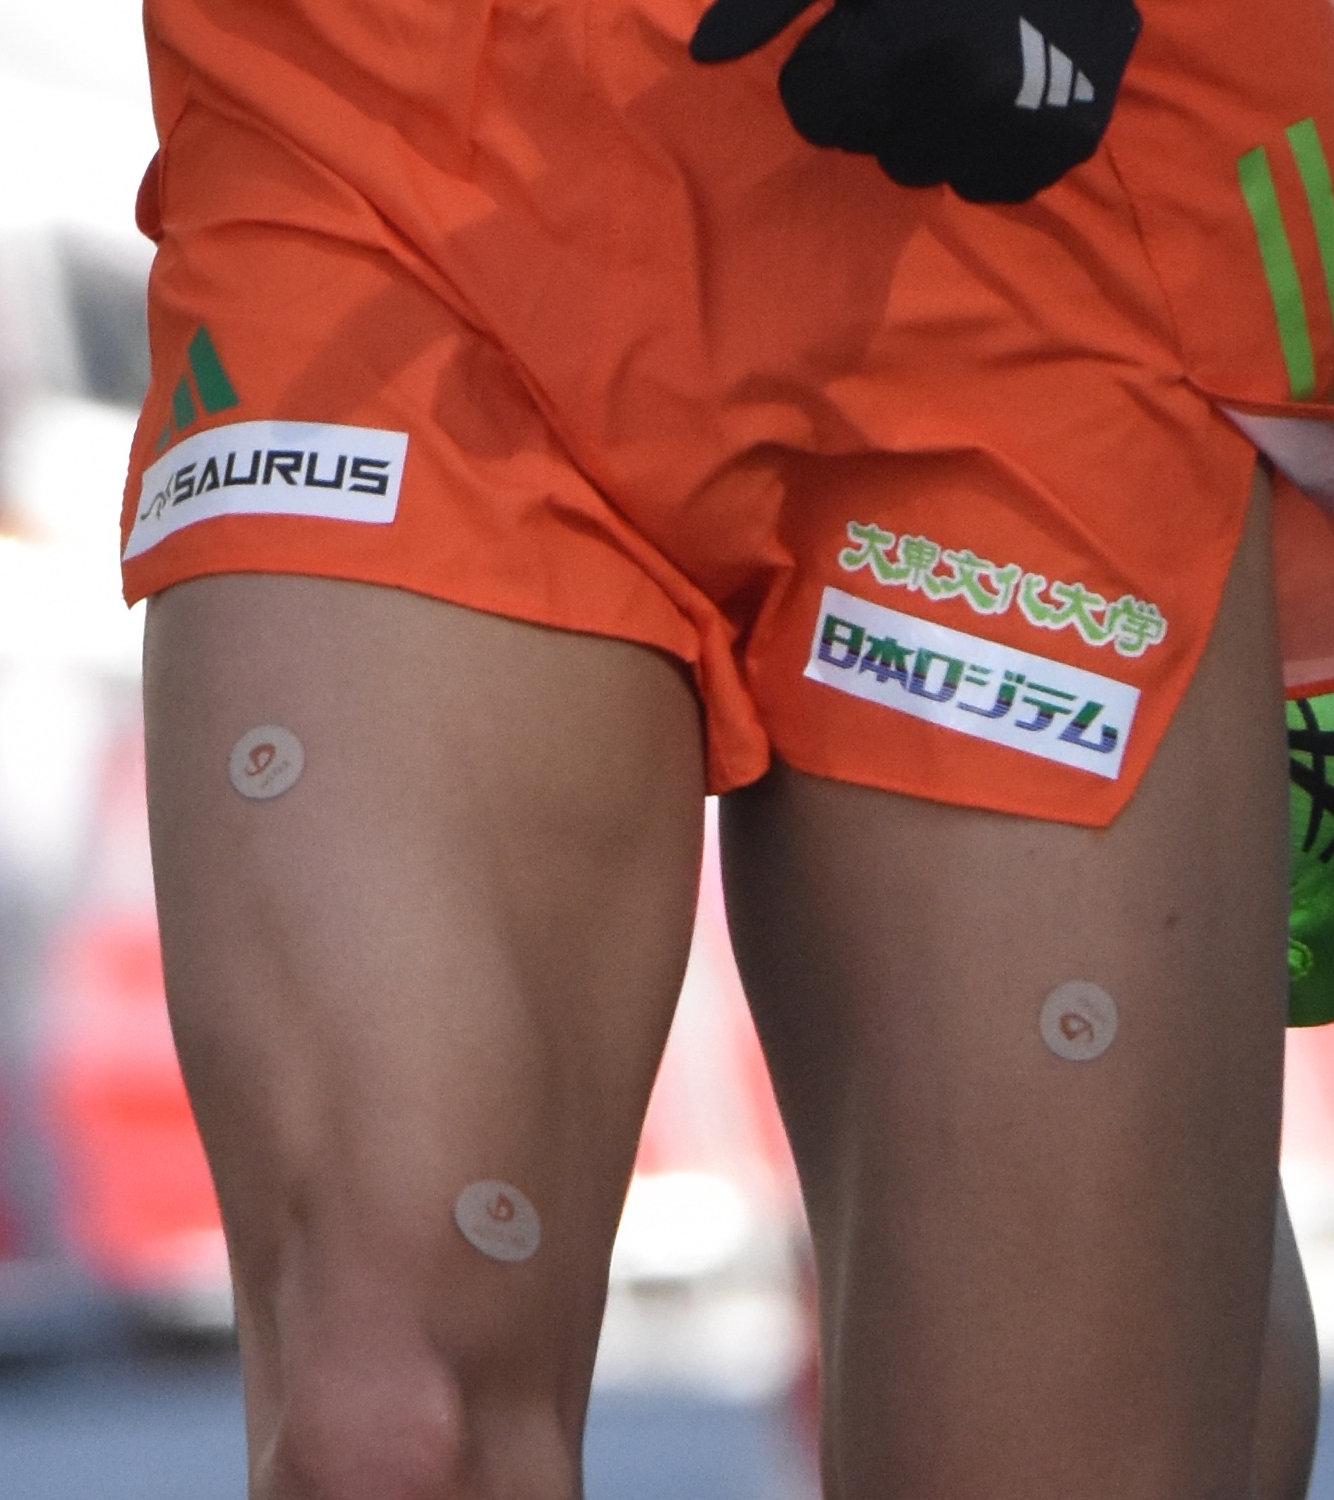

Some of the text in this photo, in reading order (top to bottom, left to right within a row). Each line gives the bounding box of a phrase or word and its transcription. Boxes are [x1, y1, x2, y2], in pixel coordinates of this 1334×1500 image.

[838, 521, 1167, 658] 大東文化大学
[816, 612, 1120, 755] 日本ロジテム
